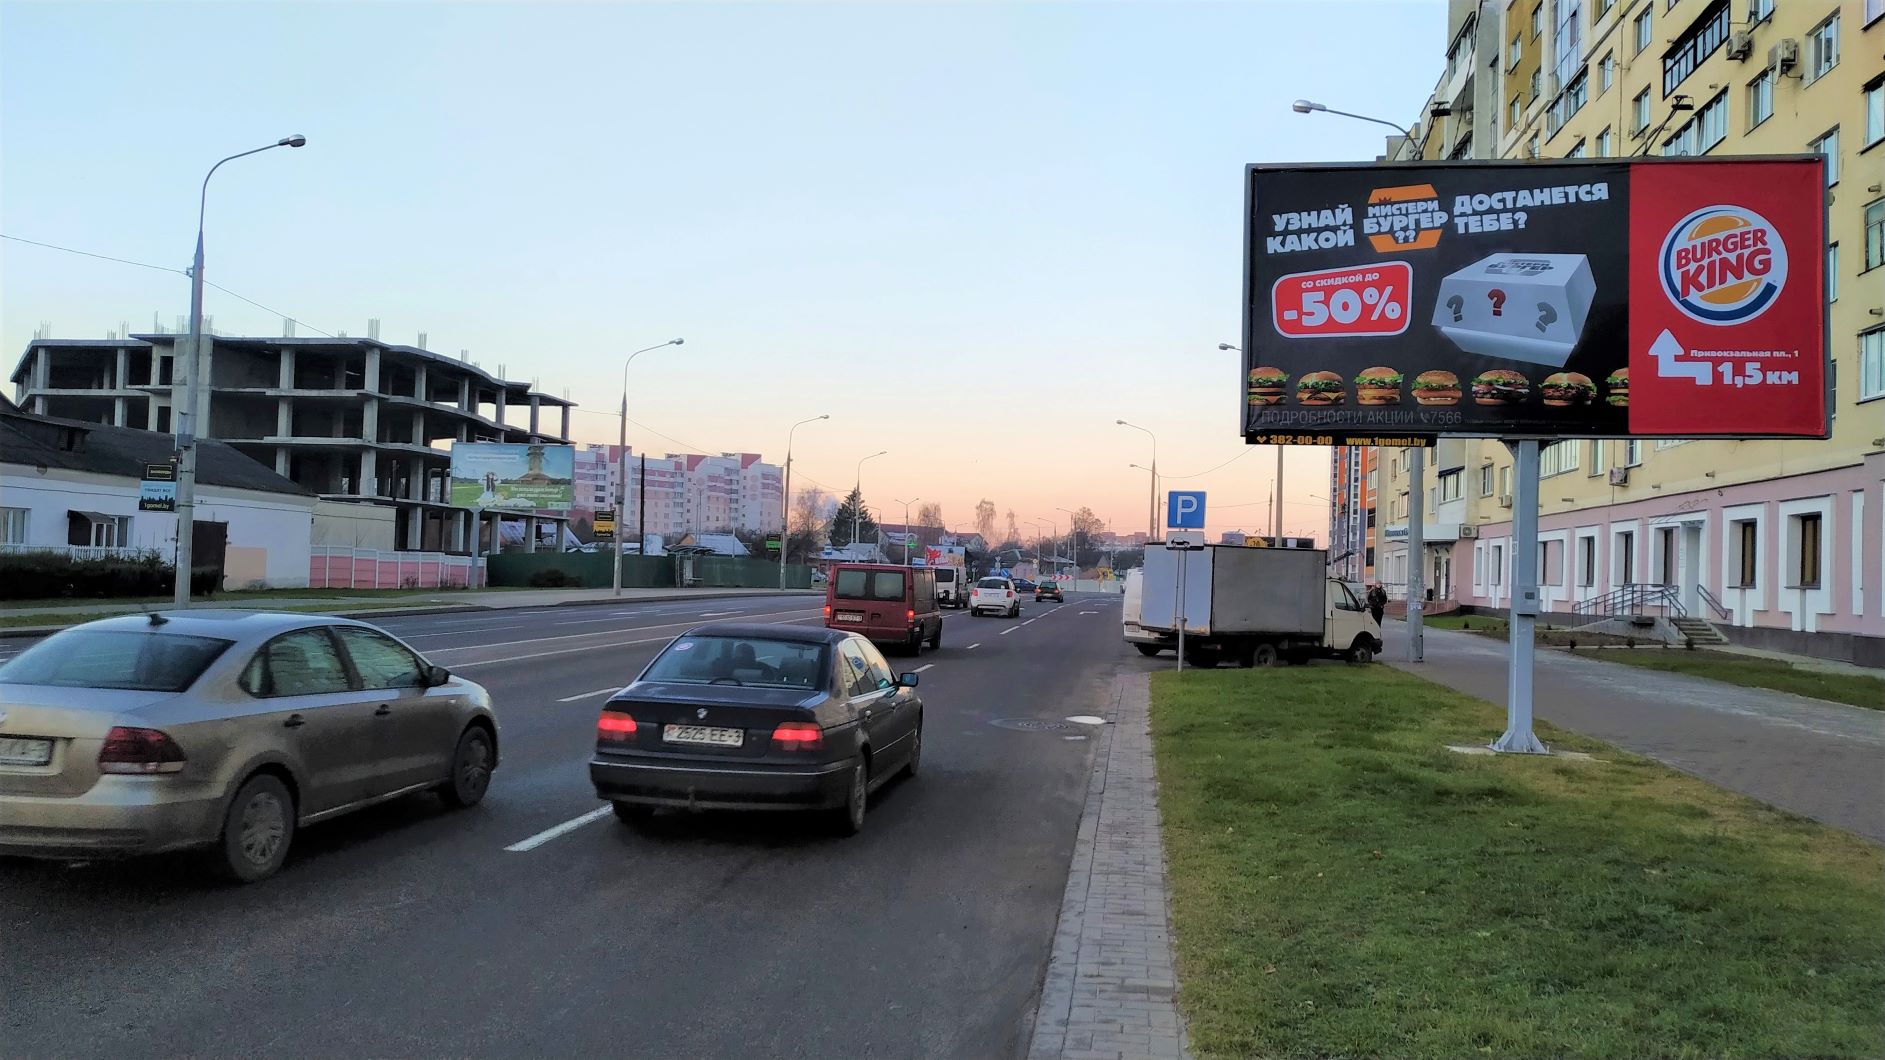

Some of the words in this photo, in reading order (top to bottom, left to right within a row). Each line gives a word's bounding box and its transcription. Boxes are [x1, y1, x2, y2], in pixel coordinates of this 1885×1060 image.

[1367, 200, 1439, 218] МИСТЕРИ
[1453, 182, 1609, 216] ДОСТАНЕТСЯ
[1272, 203, 1353, 231] УЗНАЙ
[1363, 211, 1449, 234] БУРГЕР
[1454, 211, 1528, 234] ТЕБЕ?
[1266, 225, 1355, 254] КАКОЙ
[1676, 228, 1768, 270] BURGER
[1301, 281, 1314, 289] СО
[1315, 274, 1363, 287] СКИДКОЙ
[1364, 272, 1380, 282] ДО
[1681, 247, 1772, 299] KING
[1283, 285, 1402, 327] -50%
[1690, 349, 1771, 357] Привокзальная
[1717, 361, 1763, 388] 1,5
[1766, 371, 1799, 385] км
[1261, 410, 1363, 426] ПОДРОБНОСТИ
[1366, 411, 1414, 425] АКЦИИ
[1430, 411, 1462, 424] 7566
[1269, 434, 1333, 445] 382-00-00
[1346, 437, 1427, 447] www.1gomel.by
[1176, 495, 1198, 525] P
